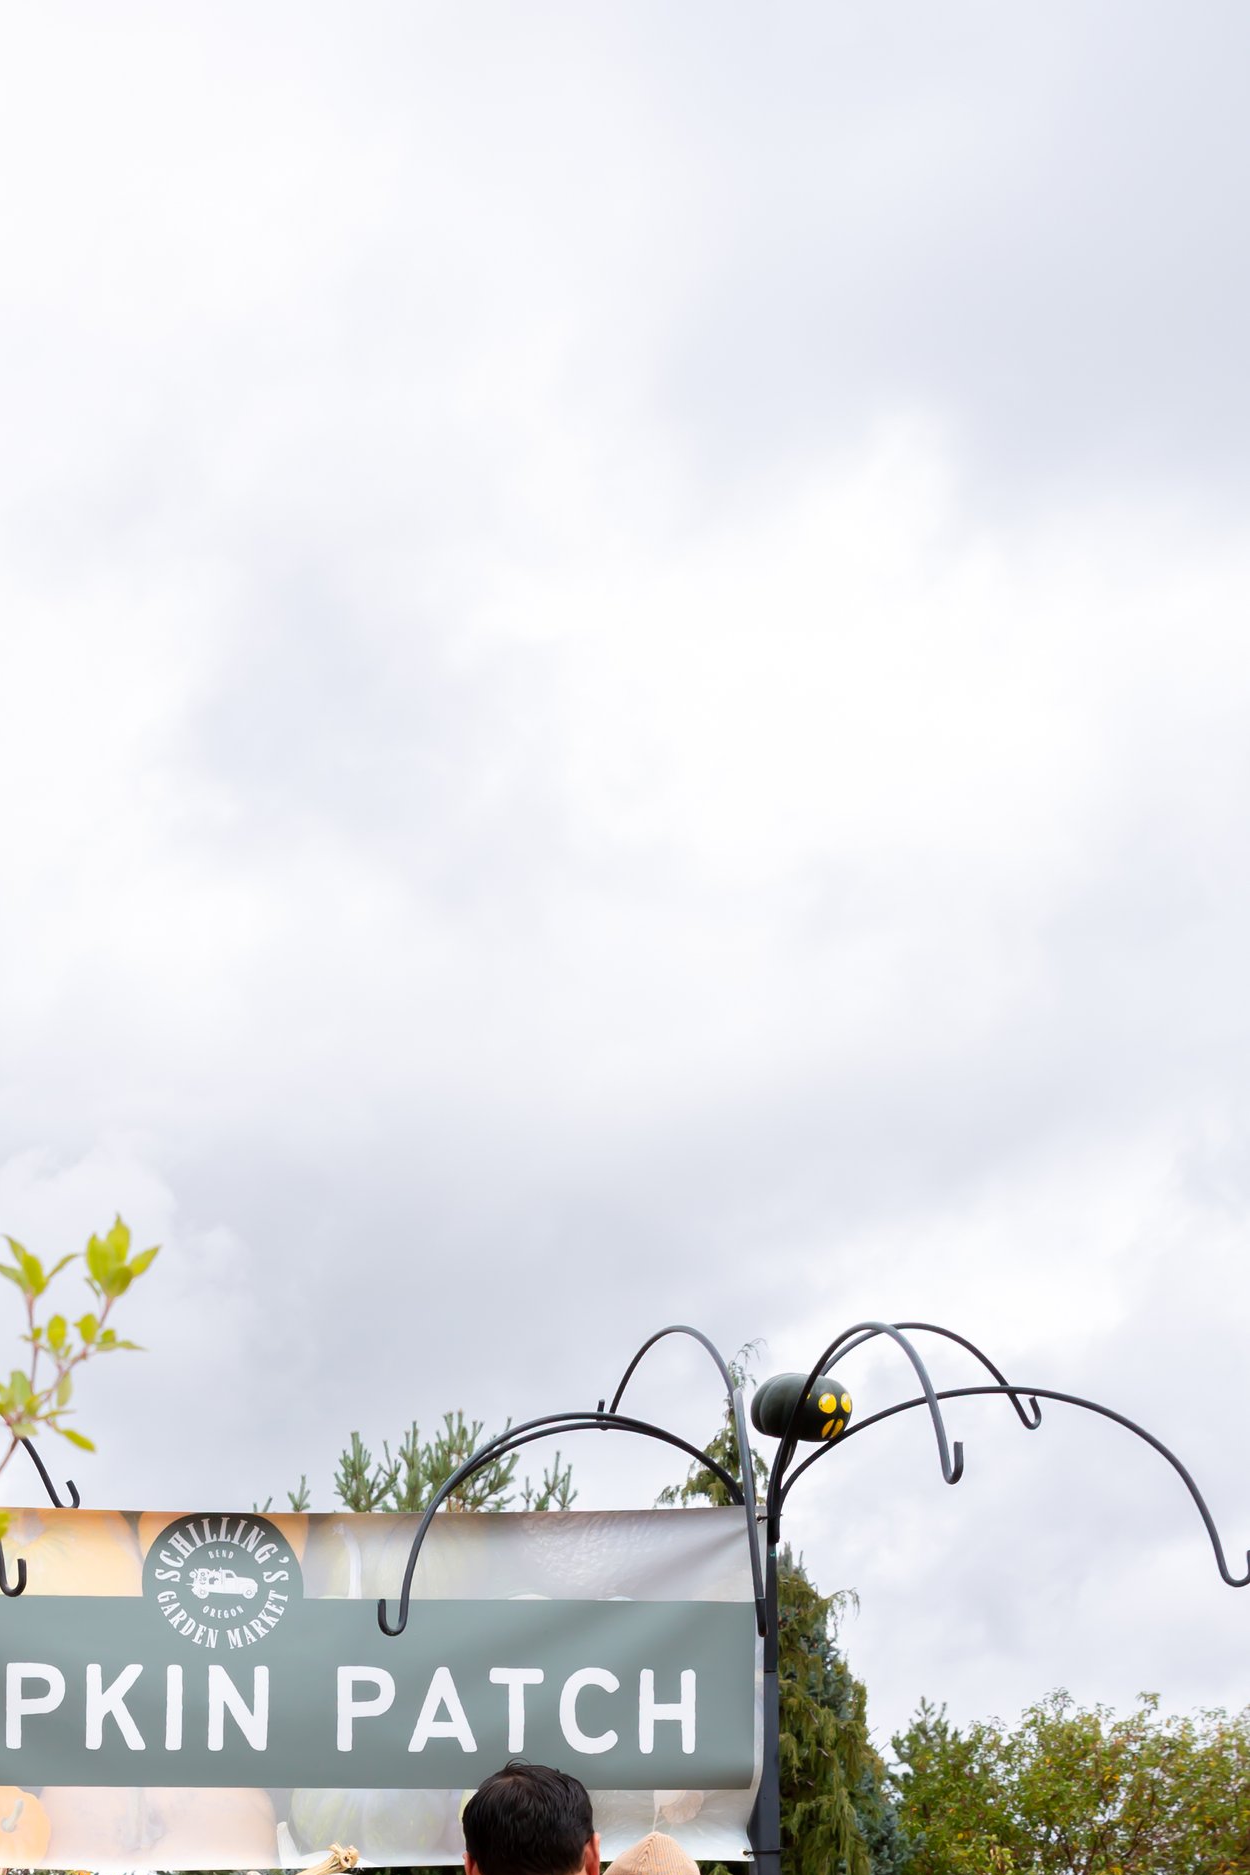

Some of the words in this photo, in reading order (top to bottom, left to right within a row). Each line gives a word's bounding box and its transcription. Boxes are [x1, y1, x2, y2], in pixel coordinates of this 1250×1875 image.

[155, 1517, 290, 1583] SCHILLING'S
[208, 1549, 234, 1559] BEND
[157, 1590, 219, 1649] GARDEN
[226, 1589, 288, 1649] MARKET
[202, 1605, 244, 1618] OREGON
[336, 1664, 696, 1755] PATCH
